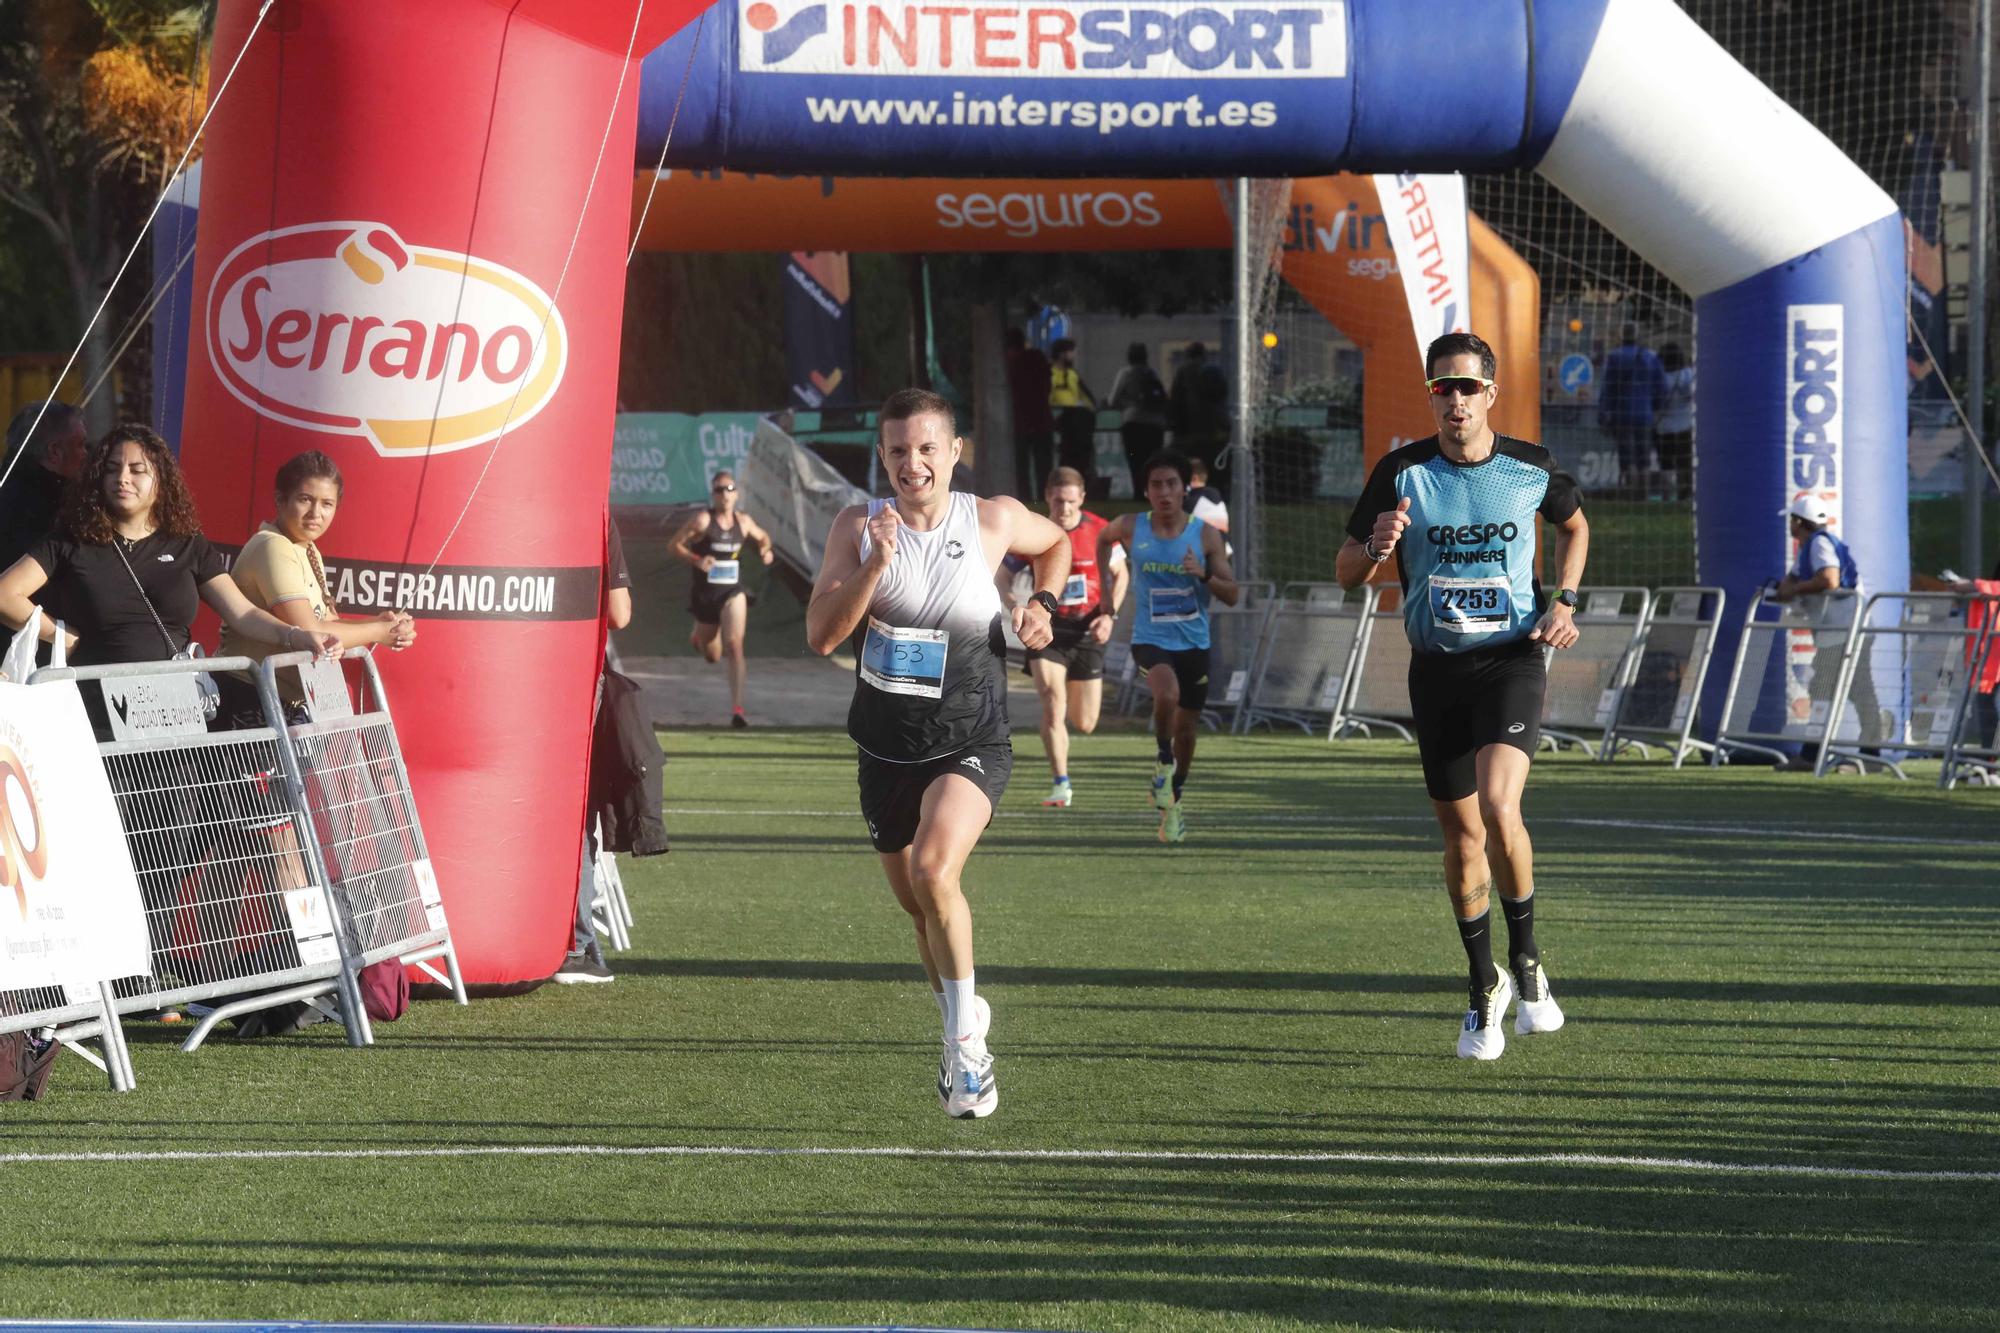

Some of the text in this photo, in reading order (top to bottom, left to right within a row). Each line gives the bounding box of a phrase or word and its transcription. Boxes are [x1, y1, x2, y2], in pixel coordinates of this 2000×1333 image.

[843, 4, 1323, 70] INTERSPORT
[806, 91, 1277, 133] www.intersport.es
[935, 190, 1162, 237] seguros
[228, 276, 533, 384] Serrano
[1427, 522, 1518, 546] CRESPO
[1440, 550, 1505, 563] RUNNERS
[1441, 589, 1497, 610] 2253
